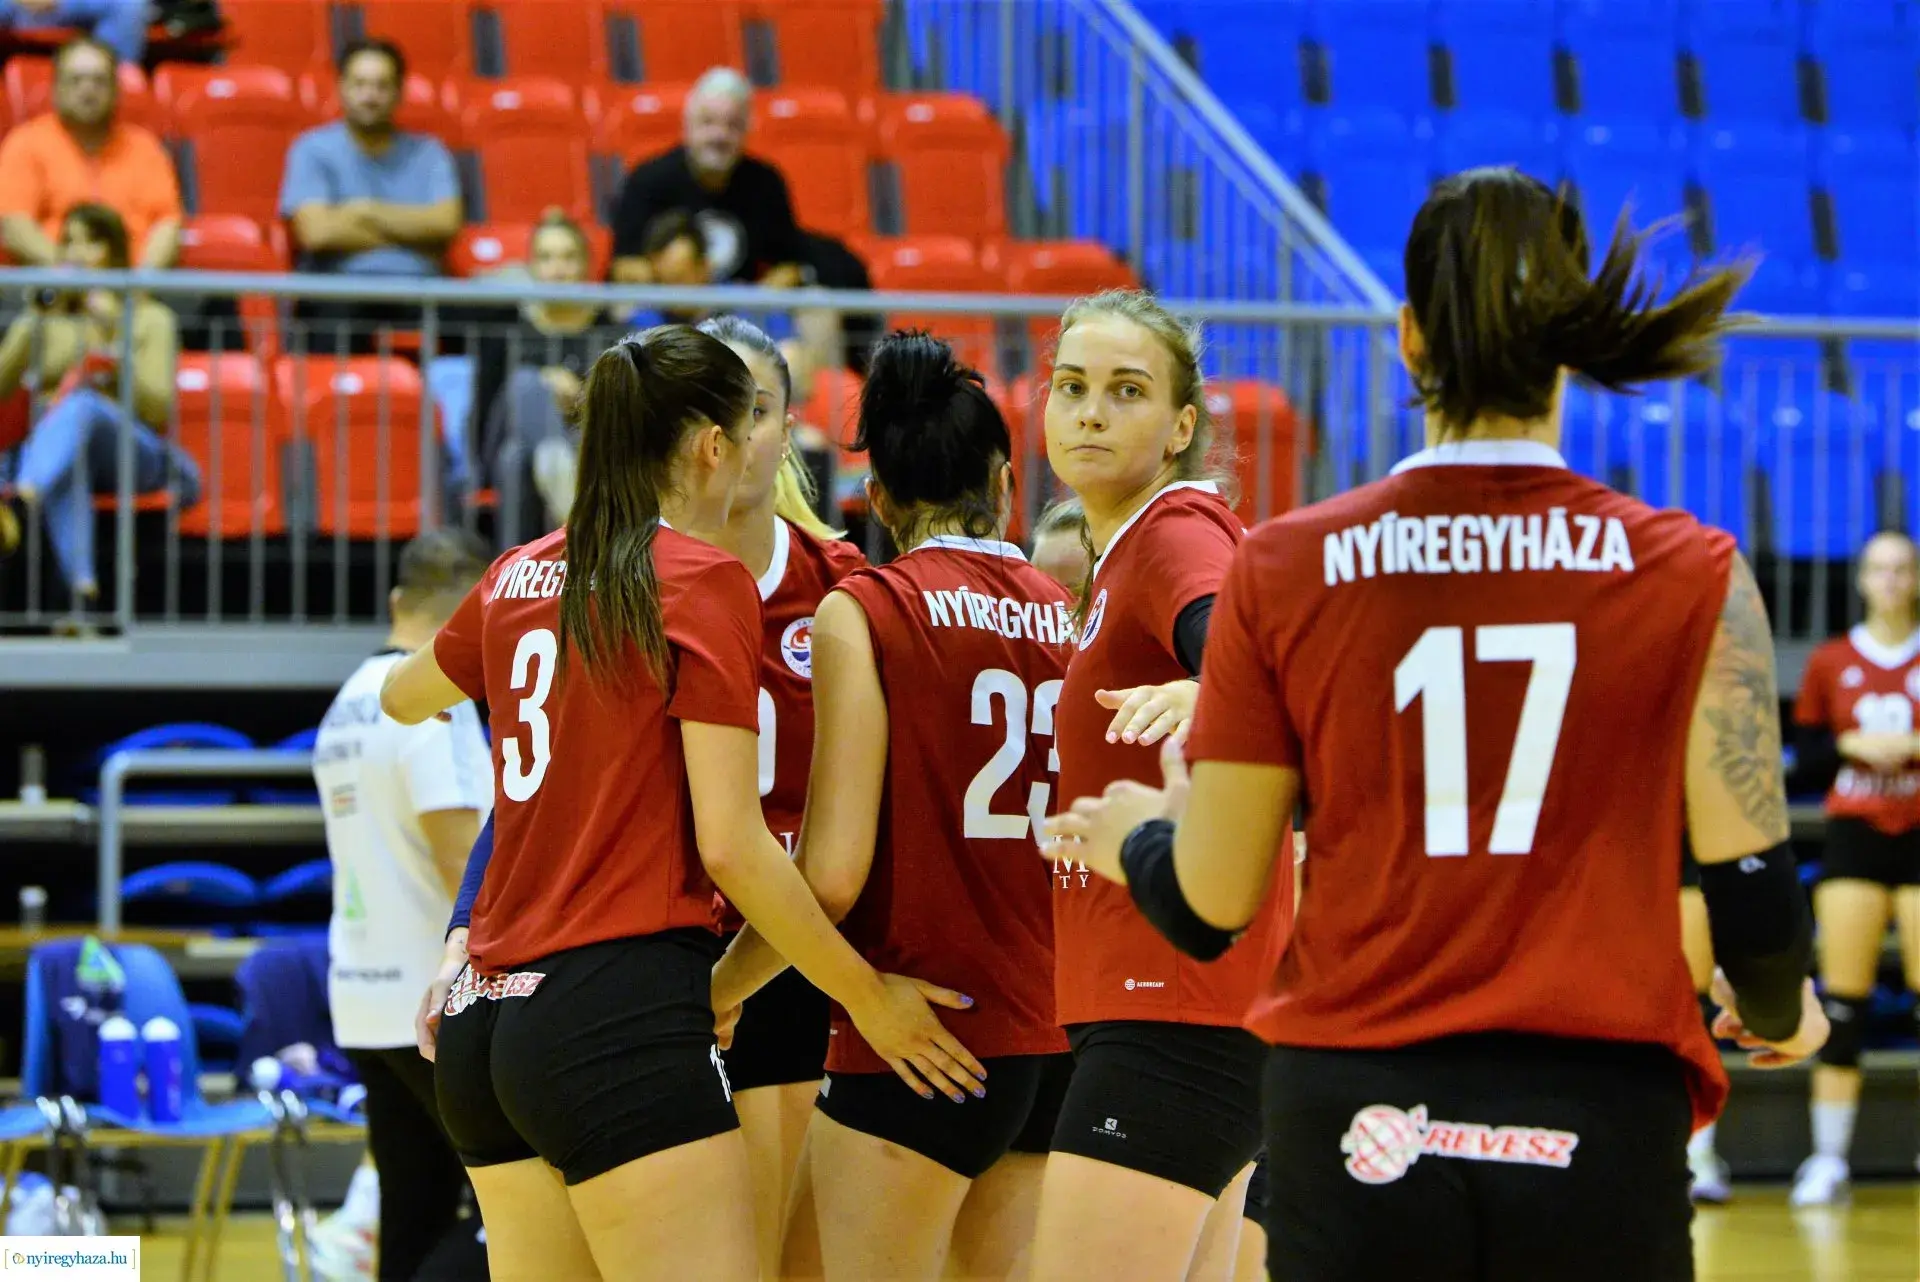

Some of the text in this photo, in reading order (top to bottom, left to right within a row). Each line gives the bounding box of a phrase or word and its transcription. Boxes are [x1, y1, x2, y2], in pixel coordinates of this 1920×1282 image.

[1324, 506, 1635, 586] NYÍREGYHÁZA
[923, 585, 1080, 645] NYÍREGYHÁ
[502, 628, 558, 802] 3
[1393, 622, 1578, 857] 17
